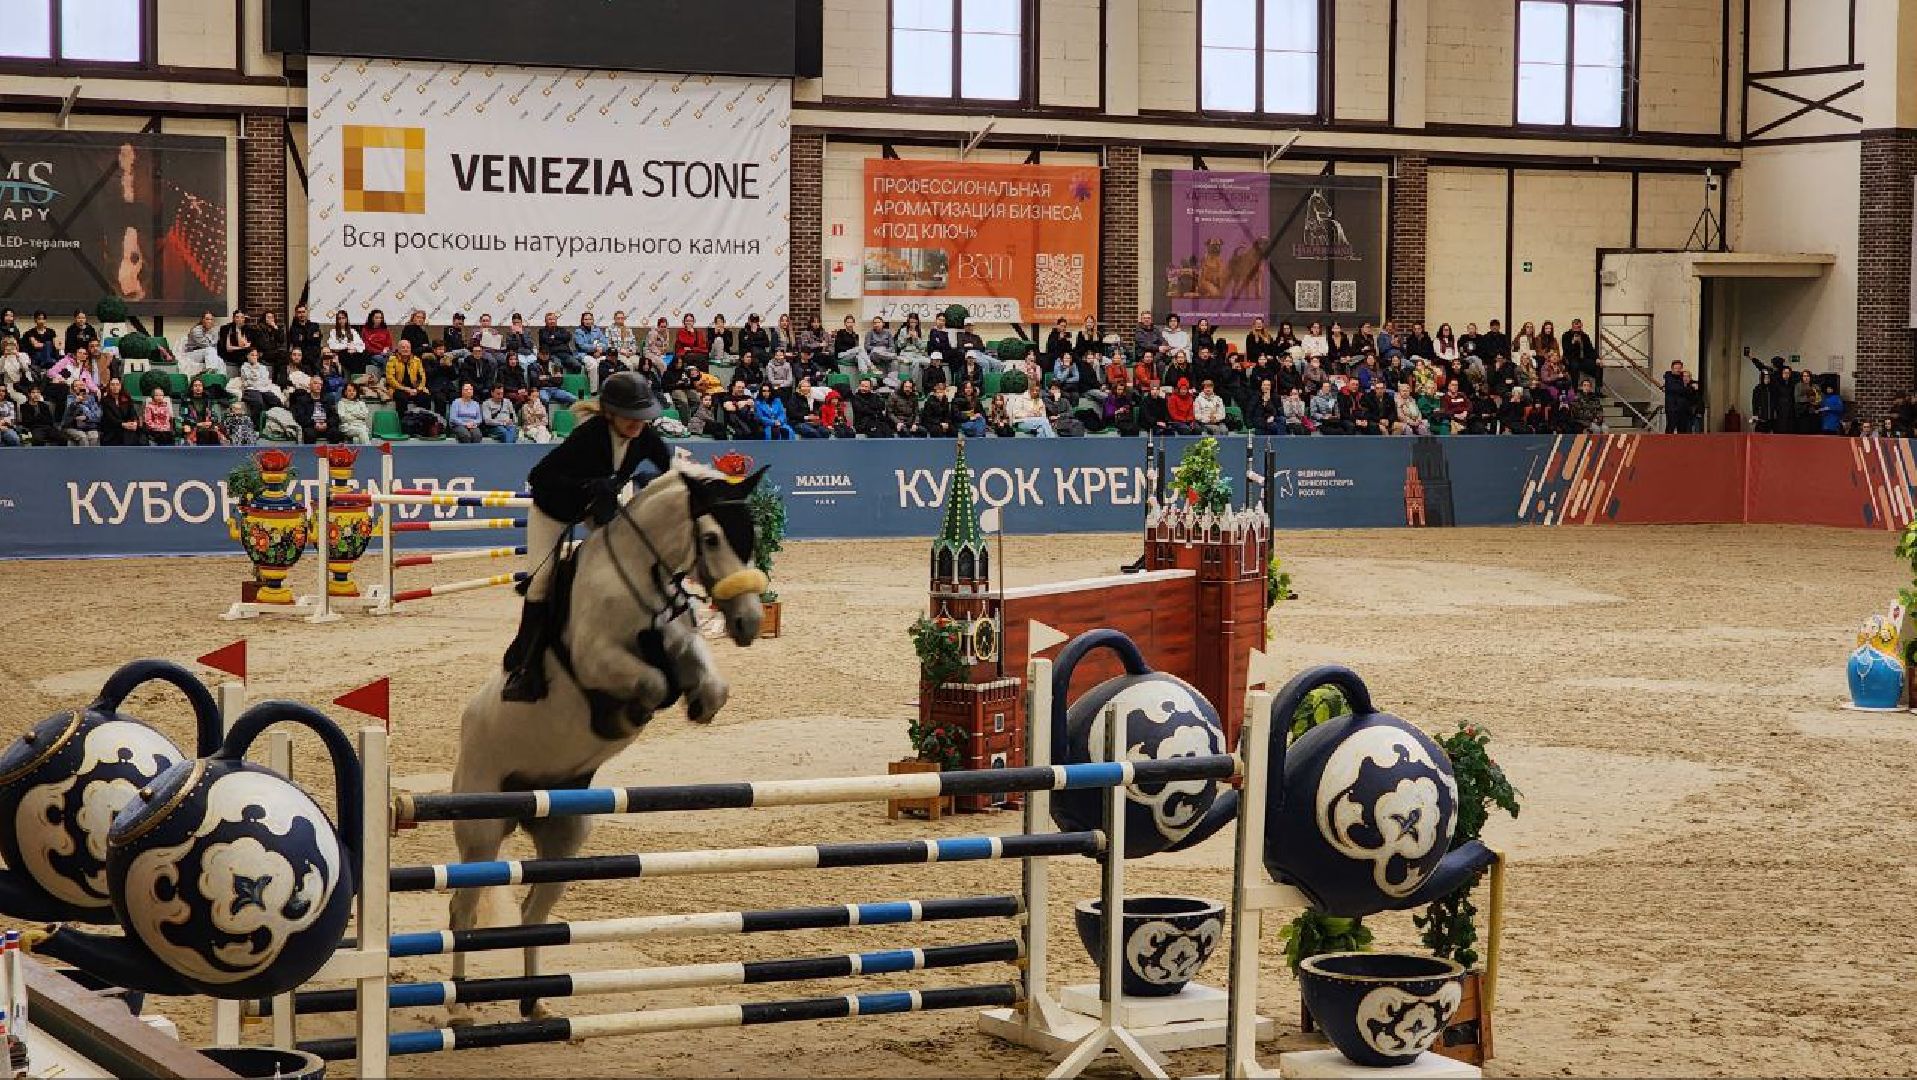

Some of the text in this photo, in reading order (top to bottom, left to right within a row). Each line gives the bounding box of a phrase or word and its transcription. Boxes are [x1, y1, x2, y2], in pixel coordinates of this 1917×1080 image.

[450, 153, 760, 200] VENEZIA STONE
[873, 177, 1051, 198] ПРОФЕССИОНАЛЬНАЯ
[873, 200, 1083, 221] АРОМАТИЗАЦИЯ БИЗНЕСА
[342, 224, 760, 260] Вся роскошь натурального камня
[873, 223, 978, 241] «ПОД КЛЮЧ»
[879, 303, 898, 318] +7
[795, 475, 852, 487] MAXIMA
